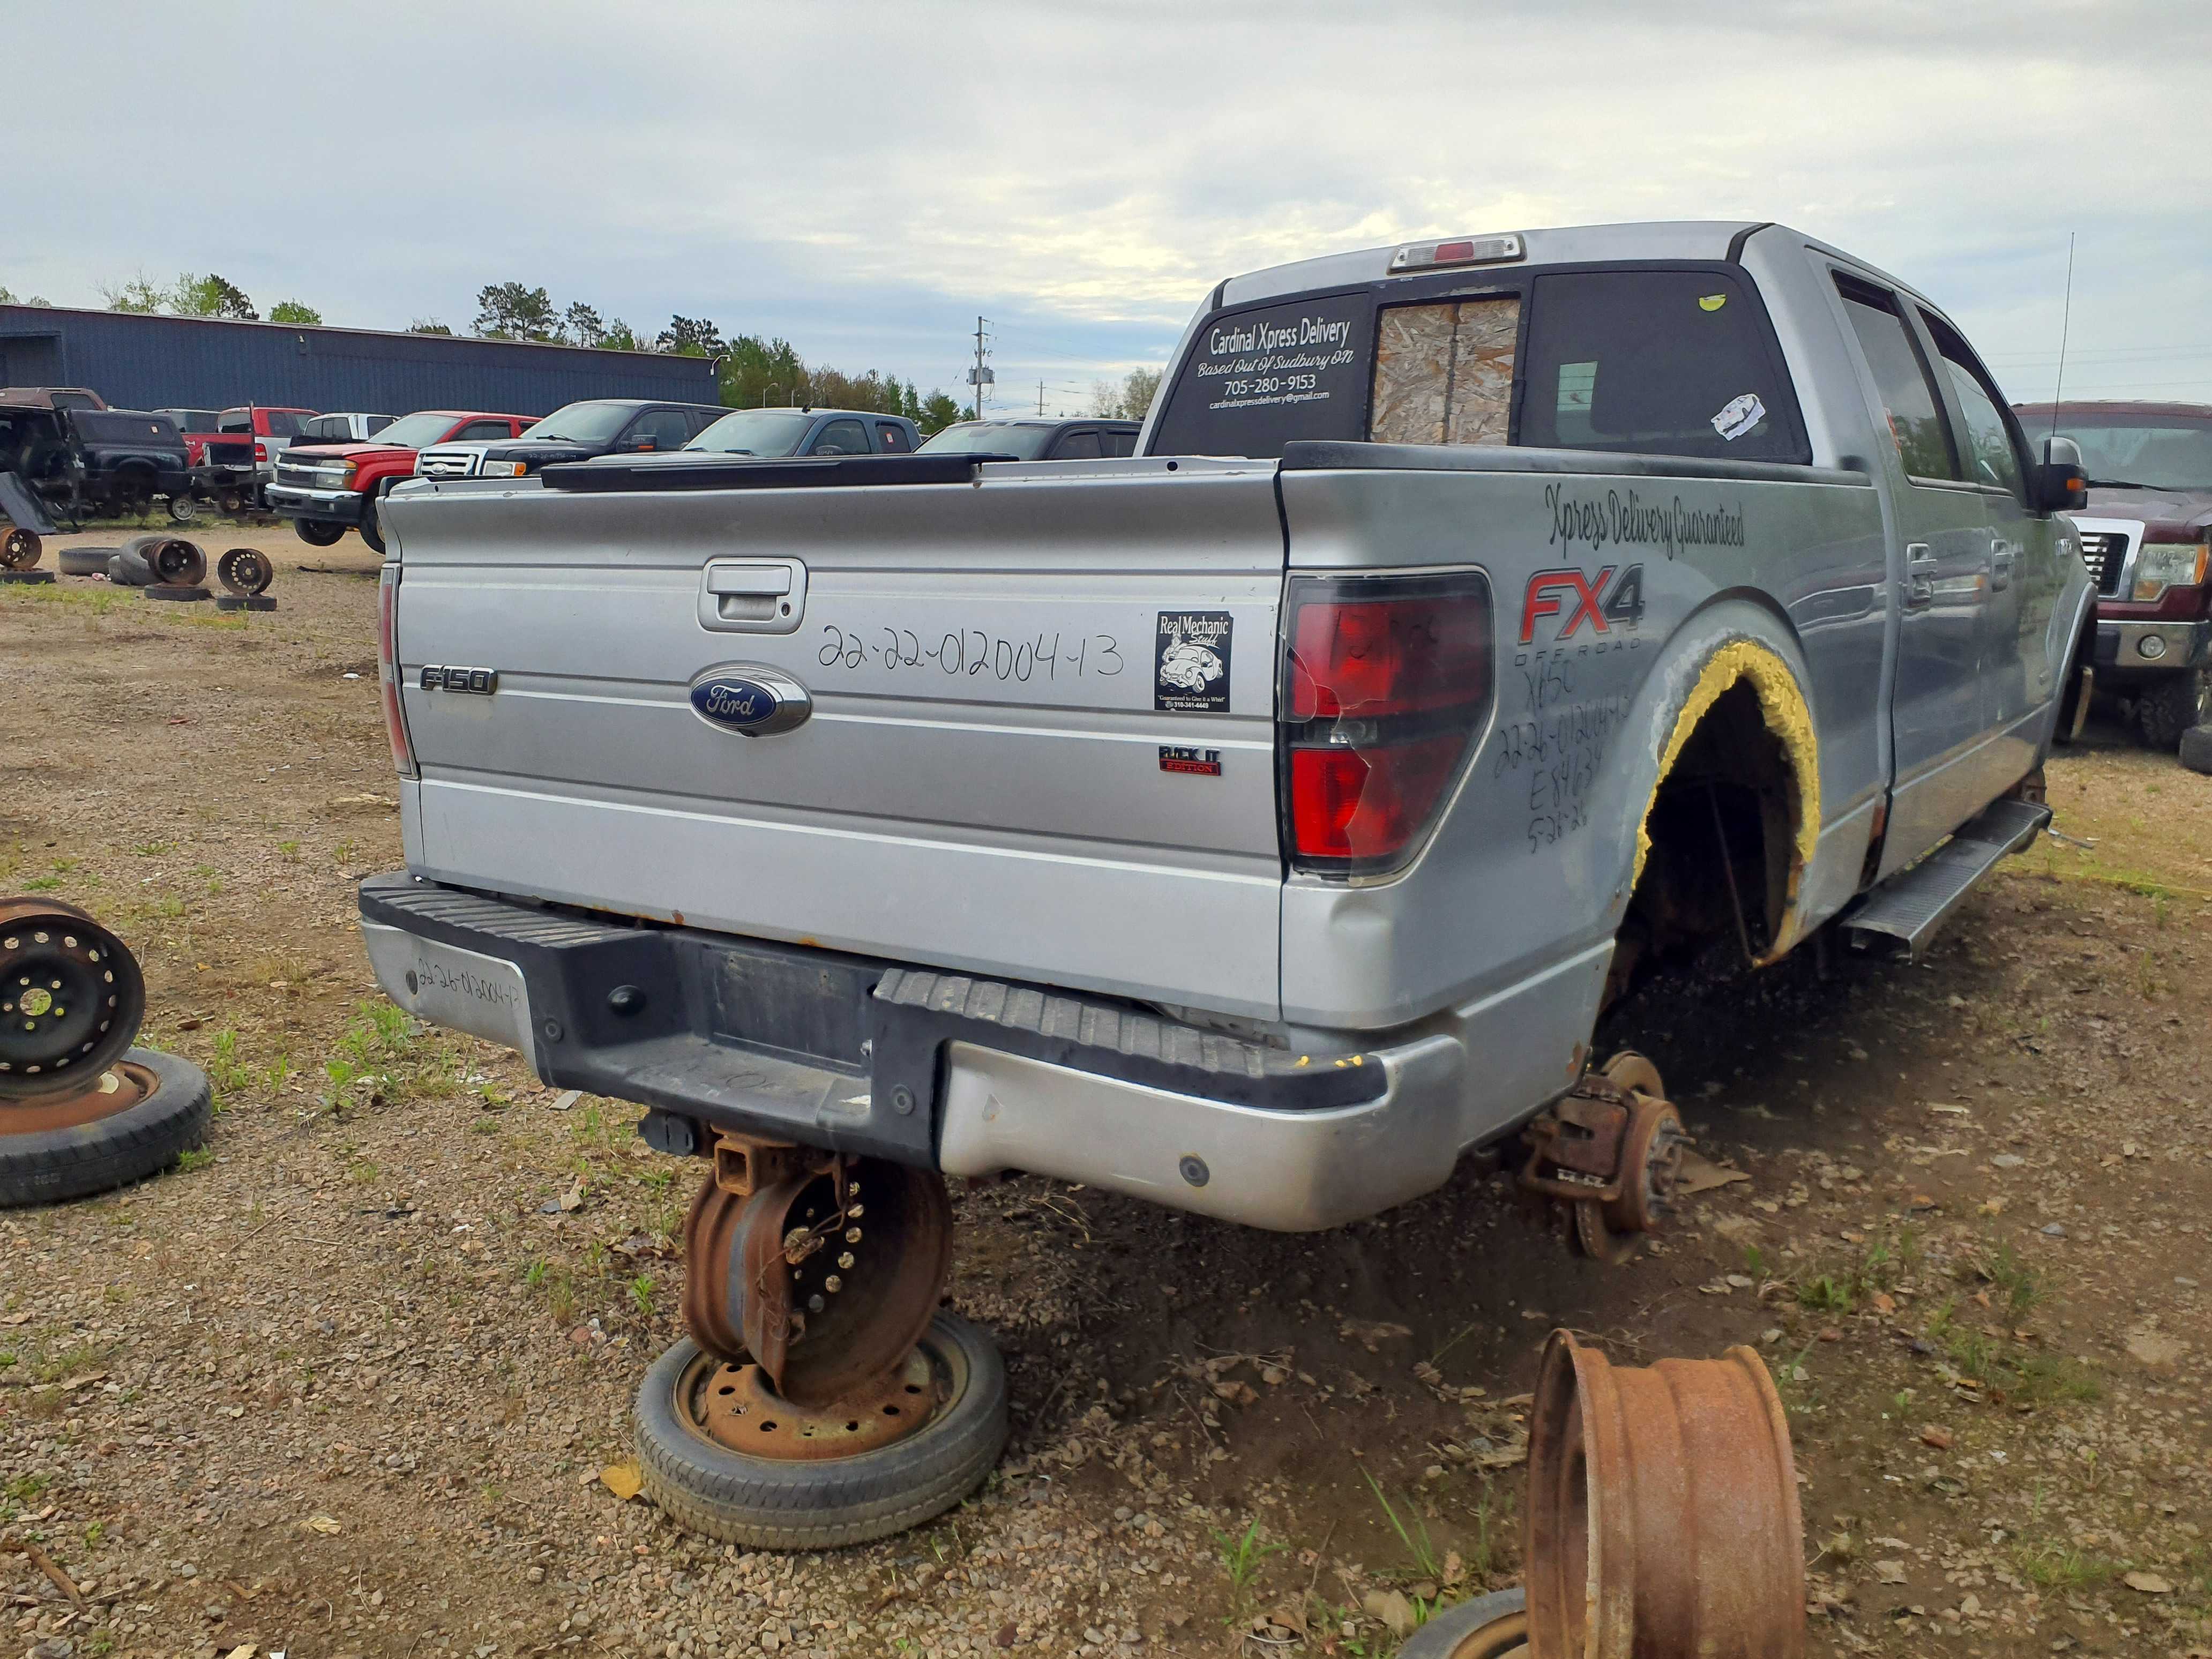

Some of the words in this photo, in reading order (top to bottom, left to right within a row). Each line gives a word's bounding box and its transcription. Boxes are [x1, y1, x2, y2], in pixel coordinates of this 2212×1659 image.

[1210, 324, 1256, 355] Cardinal
[1257, 322, 1298, 355] Xpress
[1299, 316, 1351, 348] Delivery
[1198, 359, 1236, 377] Based
[1234, 358, 1258, 374] Out
[1258, 355, 1275, 375] Of
[1273, 353, 1331, 370] Sudbury
[1223, 374, 1317, 395] 705-280-9153
[1209, 390, 1329, 409] cardinalxpressdelivery@gmail.com
[1545, 482, 1607, 560] Xpress
[1608, 488, 1673, 561] Delivery
[1673, 495, 1745, 555] Guaranteed
[1518, 563, 1646, 647] FX4
[1160, 616, 1182, 634] Real
[1182, 615, 1229, 635] Mechanic
[1189, 632, 1219, 647] Stuff
[1514, 647, 1565, 667] OFF
[1578, 638, 1641, 657] ROAD
[420, 664, 497, 696] F-150
[706, 684, 755, 716] Ford
[1167, 761, 1212, 773] EDITION
